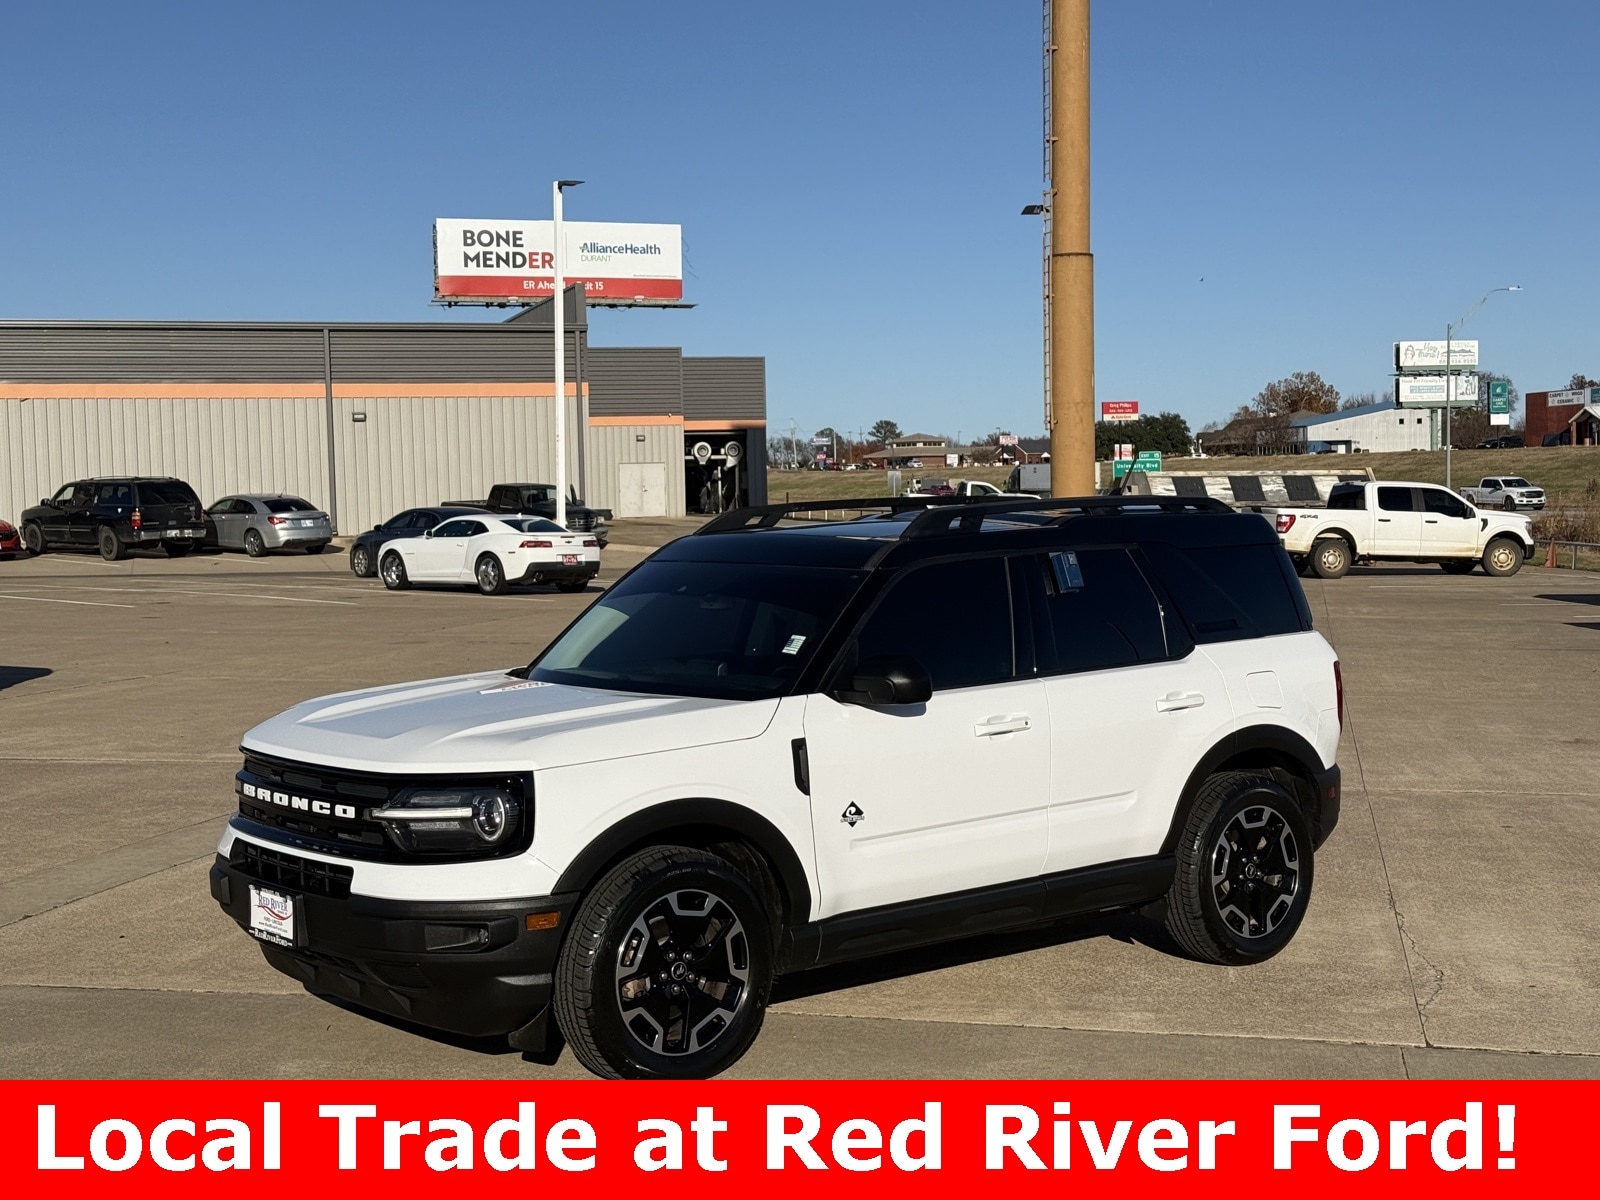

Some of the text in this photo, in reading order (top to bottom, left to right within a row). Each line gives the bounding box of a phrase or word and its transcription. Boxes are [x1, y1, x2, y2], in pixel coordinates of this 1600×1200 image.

[462, 229, 524, 247] BONE
[579, 242, 661, 255] AllianceHealth
[463, 251, 554, 269] MENDER
[523, 280, 535, 289] ER
[538, 280, 566, 290] Ahe
[595, 281, 604, 290] 15
[243, 783, 356, 819] BRONCO
[259, 894, 270, 906] RED
[270, 897, 288, 912] RIVER
